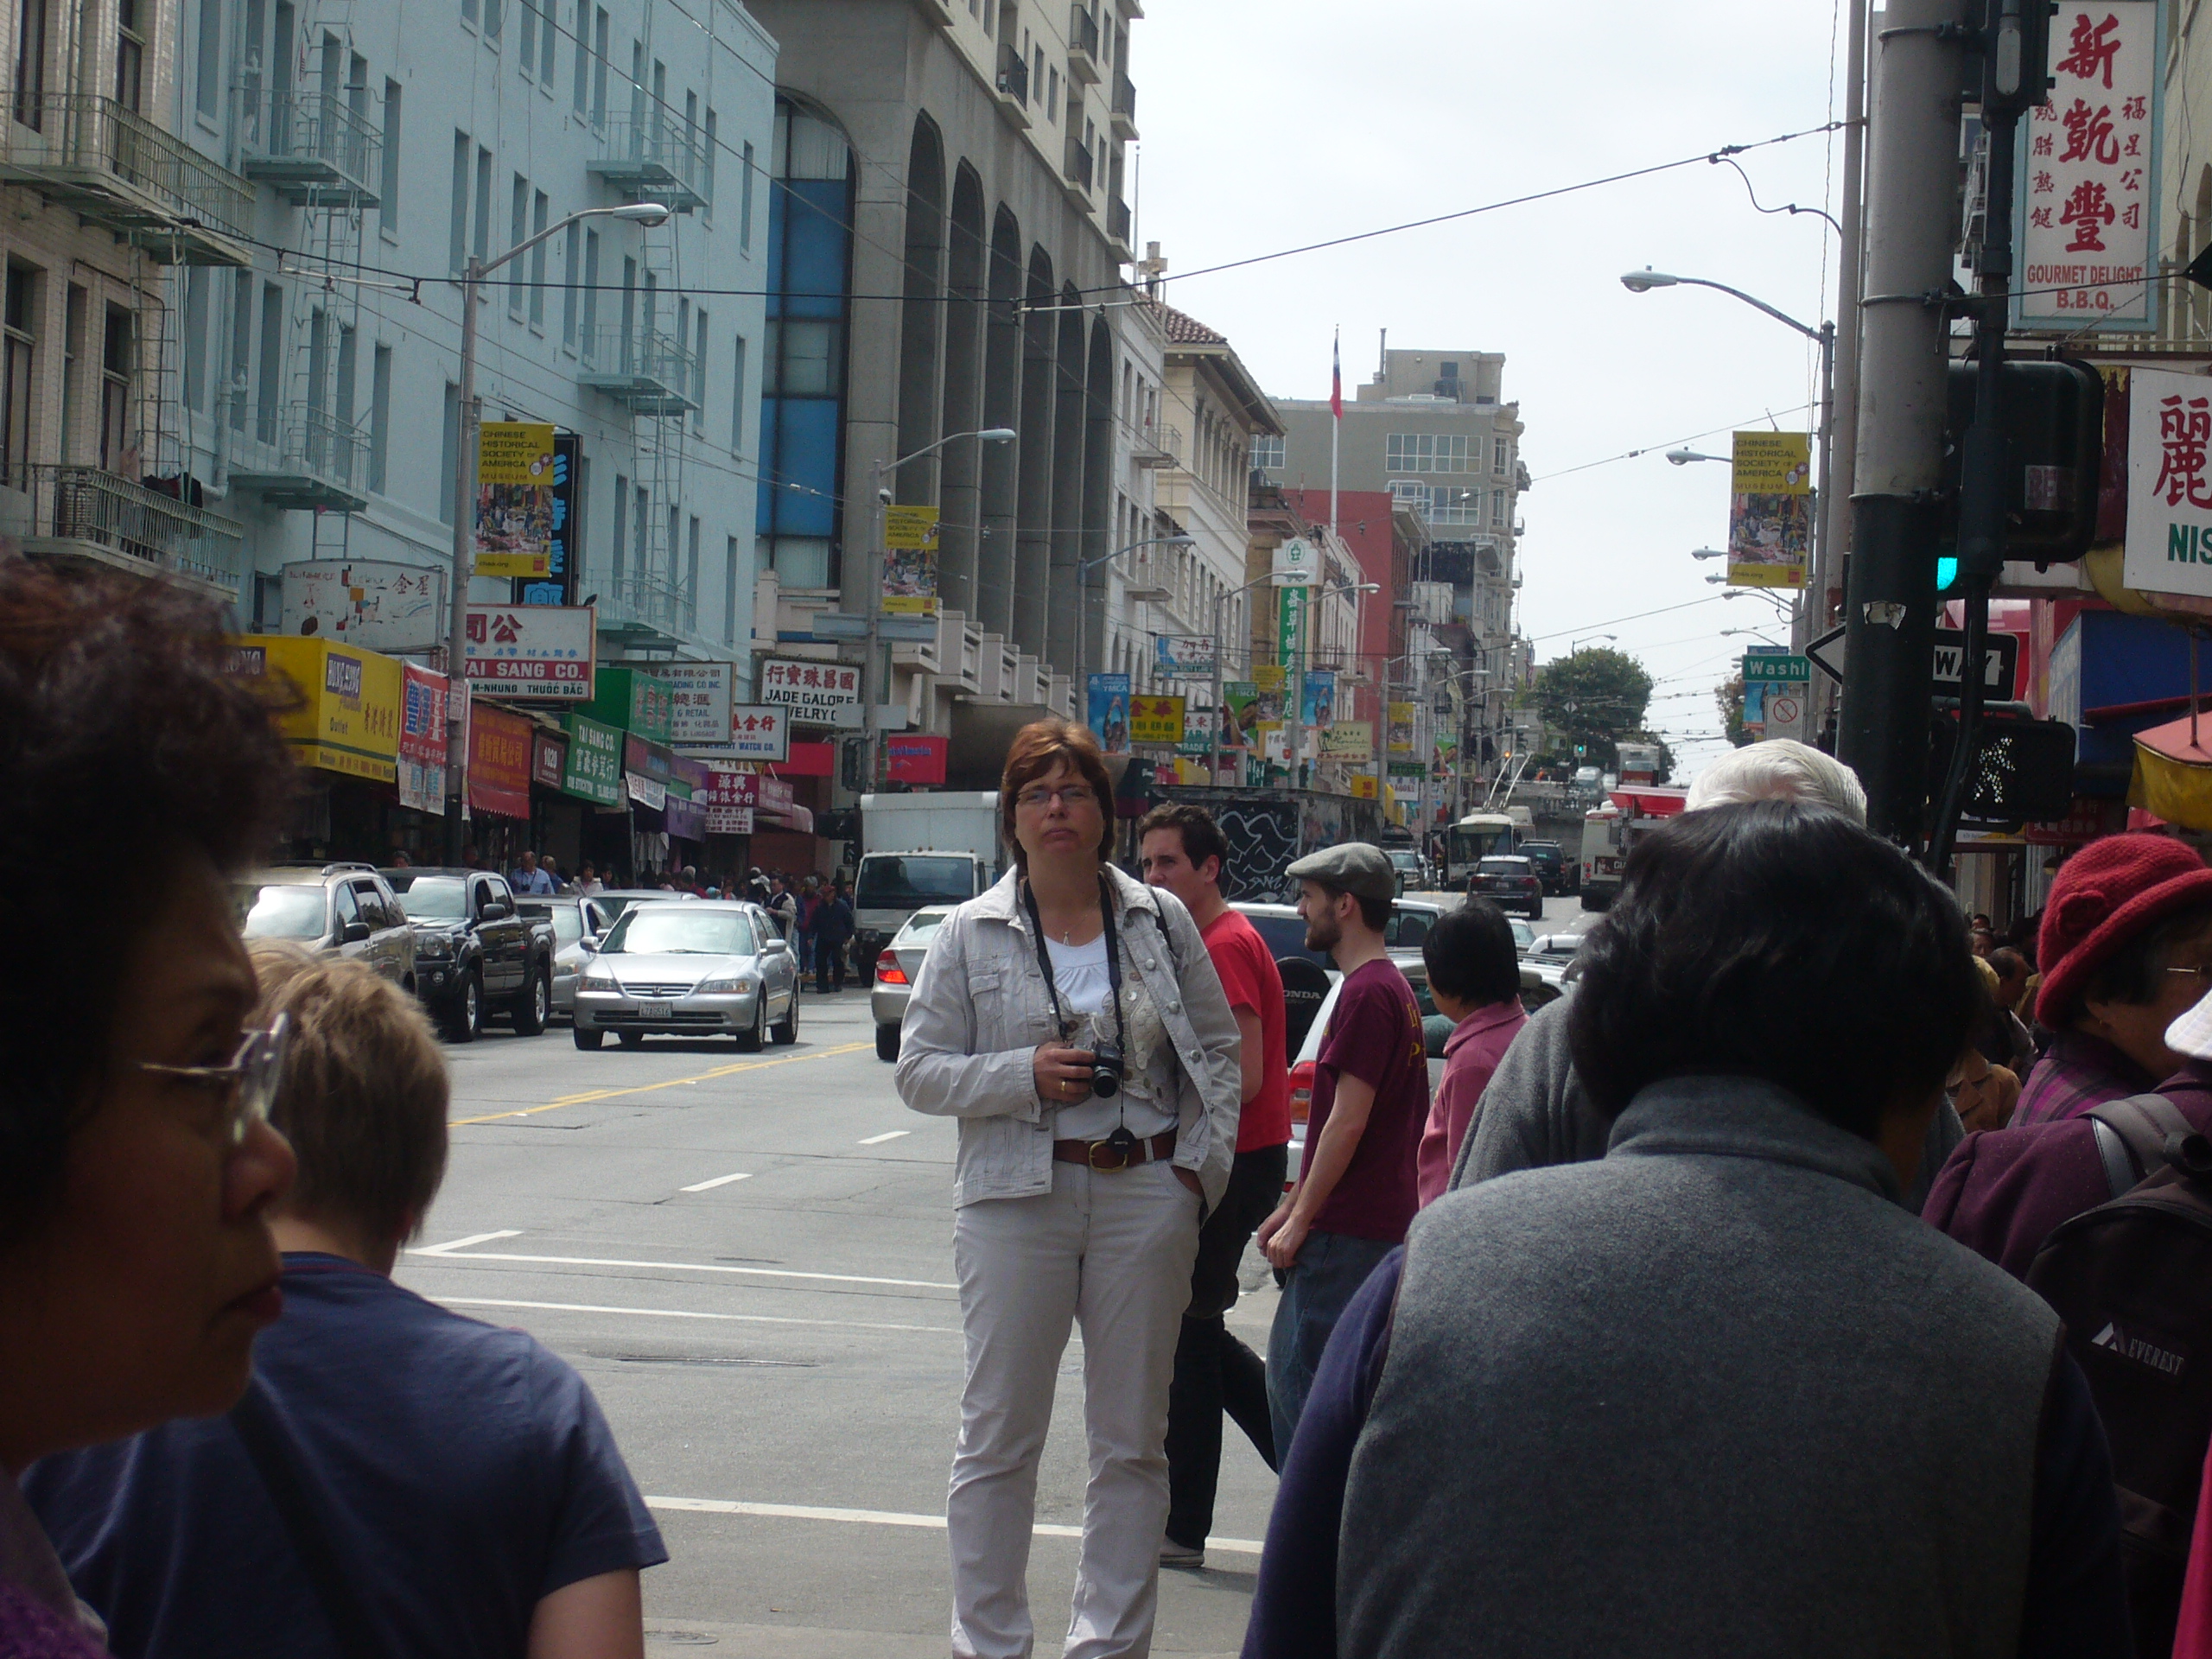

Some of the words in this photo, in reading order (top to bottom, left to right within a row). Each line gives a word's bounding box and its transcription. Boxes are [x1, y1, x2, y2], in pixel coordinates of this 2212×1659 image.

[2027, 264, 2087, 284] GOURMET
[2090, 266, 2142, 285] DELIGHT
[2056, 290, 2115, 309] B.B.Q.
[482, 430, 526, 439] CHINESE
[482, 441, 540, 449] HISTORICAL
[1736, 449, 1796, 458] HISTORICAL
[481, 460, 526, 468] AMERICA
[466, 662, 486, 676] AI
[497, 663, 545, 677] SANG
[556, 664, 583, 678] CO.
[1749, 660, 1805, 676] Washi
[473, 683, 518, 693] M-NHUNG
[766, 689, 798, 703] JADE
[685, 709, 709, 717] RETAIL
[739, 742, 761, 751] WATCH
[1282, 989, 1322, 1000] ONDA
[2128, 1338, 2184, 1376] EVEREST
